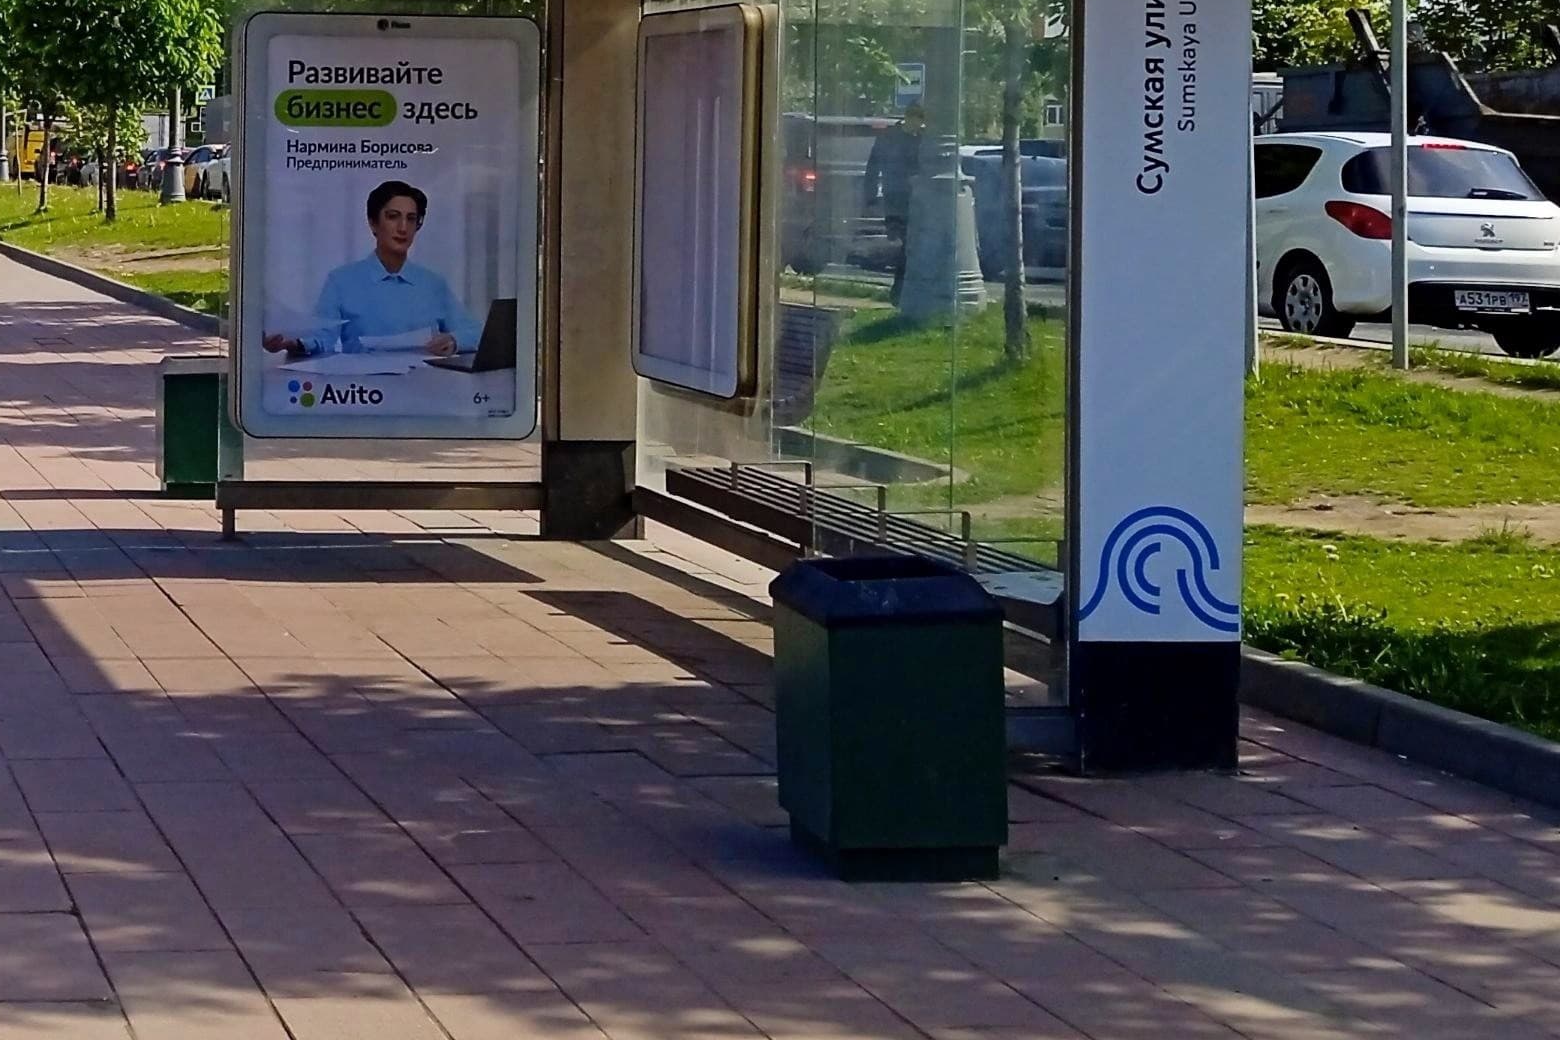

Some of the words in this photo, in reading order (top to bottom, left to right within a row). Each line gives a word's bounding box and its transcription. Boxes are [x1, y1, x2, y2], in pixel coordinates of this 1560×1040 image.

[288, 60, 443, 85] Развивайте
[1177, 22, 1201, 132] Sumskaya
[287, 95, 383, 119] бизнес
[402, 101, 478, 124] здесь
[1135, 57, 1170, 195] Сумская
[286, 139, 356, 156] Нармина
[360, 139, 433, 156] Борисова
[286, 157, 408, 171] Предприниматель
[320, 382, 383, 406] Avito
[473, 391, 490, 404] 6+
